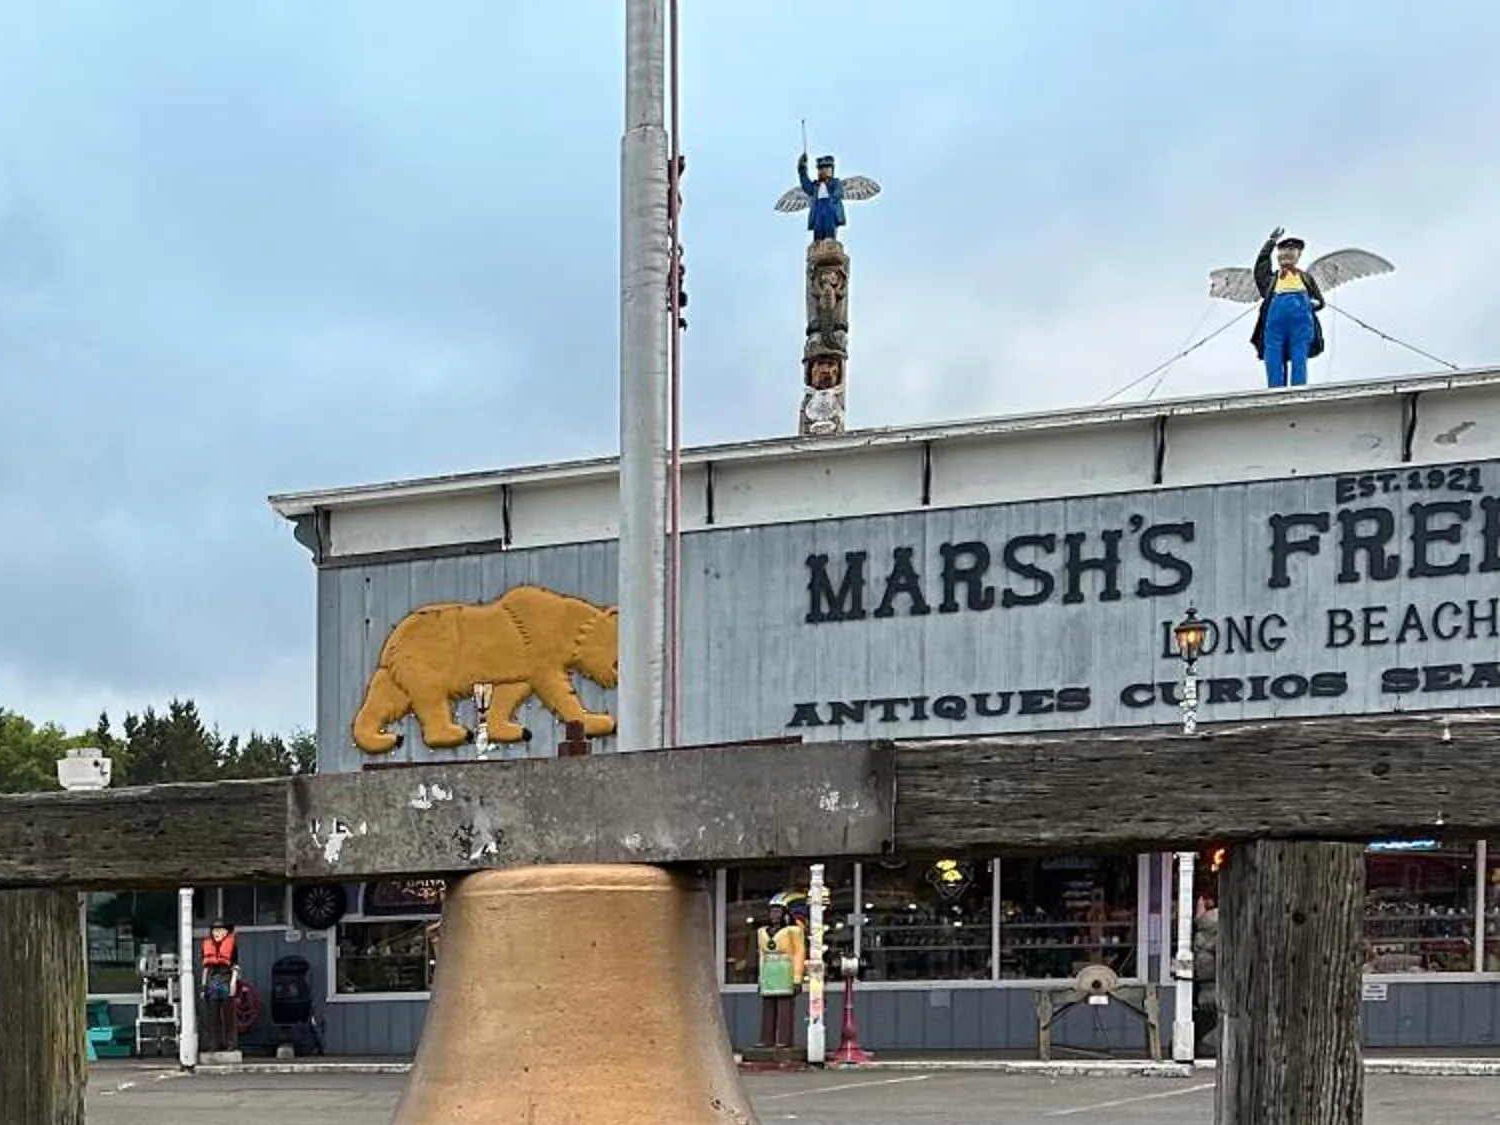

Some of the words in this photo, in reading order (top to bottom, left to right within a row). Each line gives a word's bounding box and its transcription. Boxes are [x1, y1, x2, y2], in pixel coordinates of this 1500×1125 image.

[805, 515, 1195, 623] MARSH'S
[1161, 614, 1288, 659] LONG
[1326, 597, 1500, 649] BEACH
[787, 687, 1091, 727] ANTIQUES
[1119, 672, 1350, 709] CURIOS
